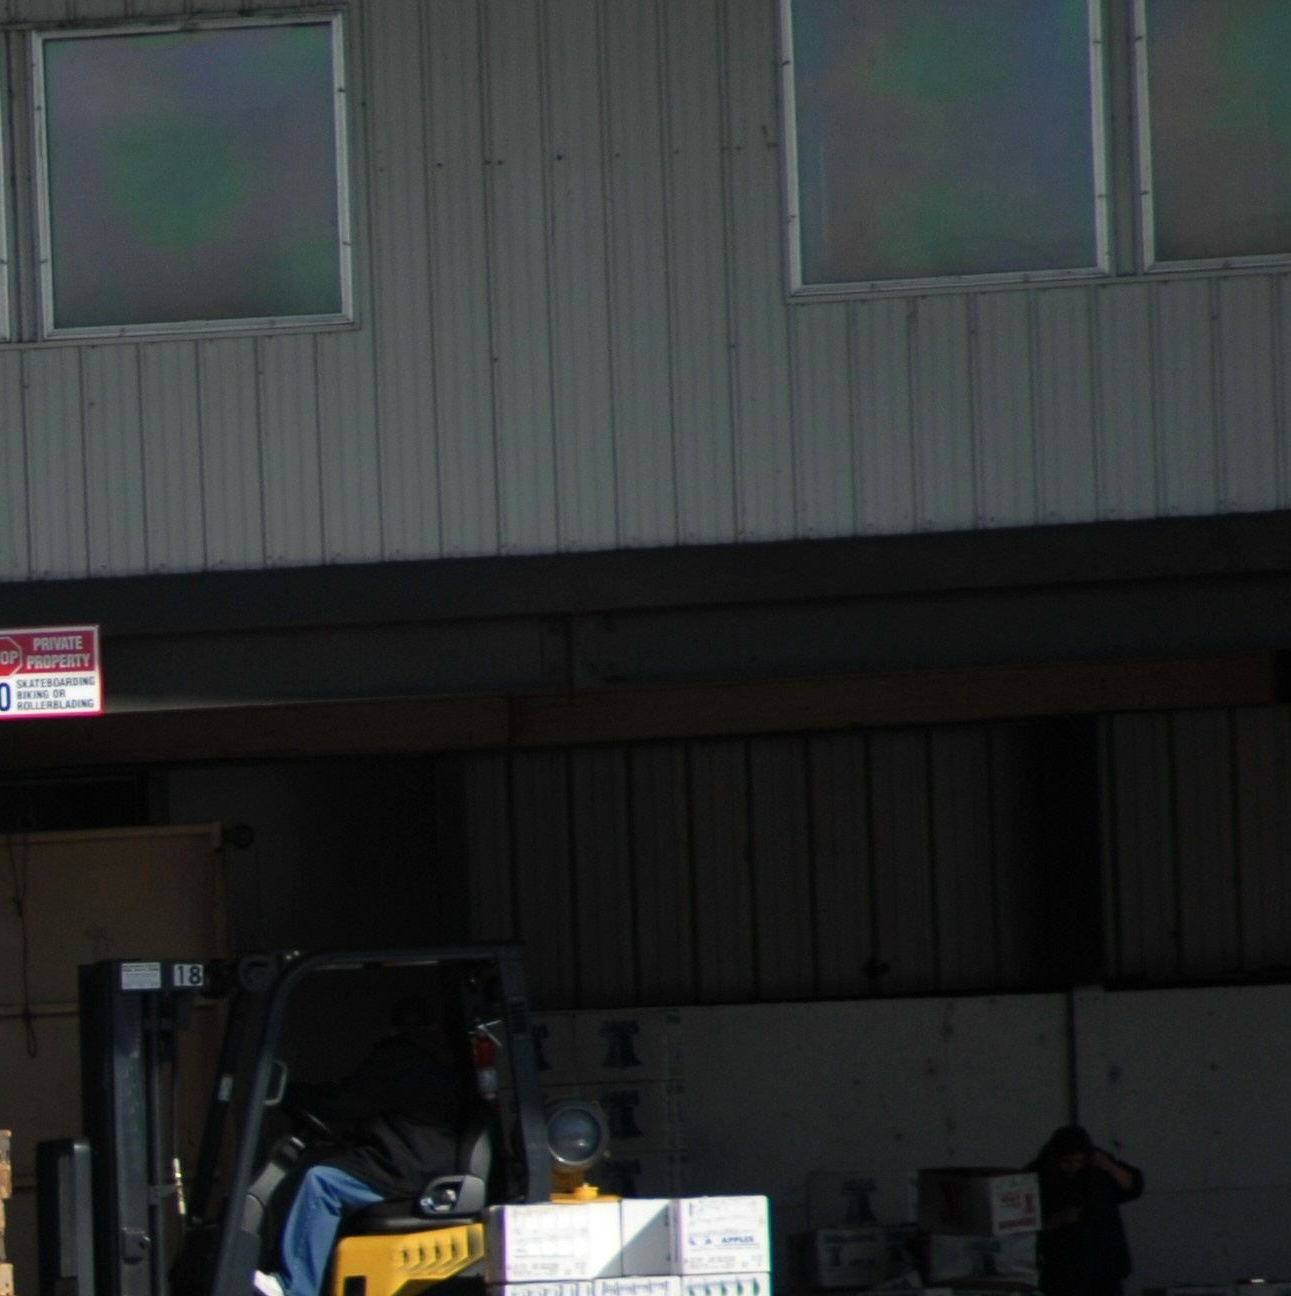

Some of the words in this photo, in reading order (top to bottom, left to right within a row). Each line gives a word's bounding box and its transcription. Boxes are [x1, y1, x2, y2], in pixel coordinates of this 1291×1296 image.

[33, 635, 83, 651] PRIVATE
[26, 653, 91, 670] PROPERTY
[16, 676, 95, 689] SKATEBOARDING
[16, 689, 50, 700] BIKING
[52, 688, 66, 698] OR
[17, 698, 95, 711] ROLLERBLADING
[176, 964, 202, 985] 18
[721, 1234, 755, 1245] APPLES
